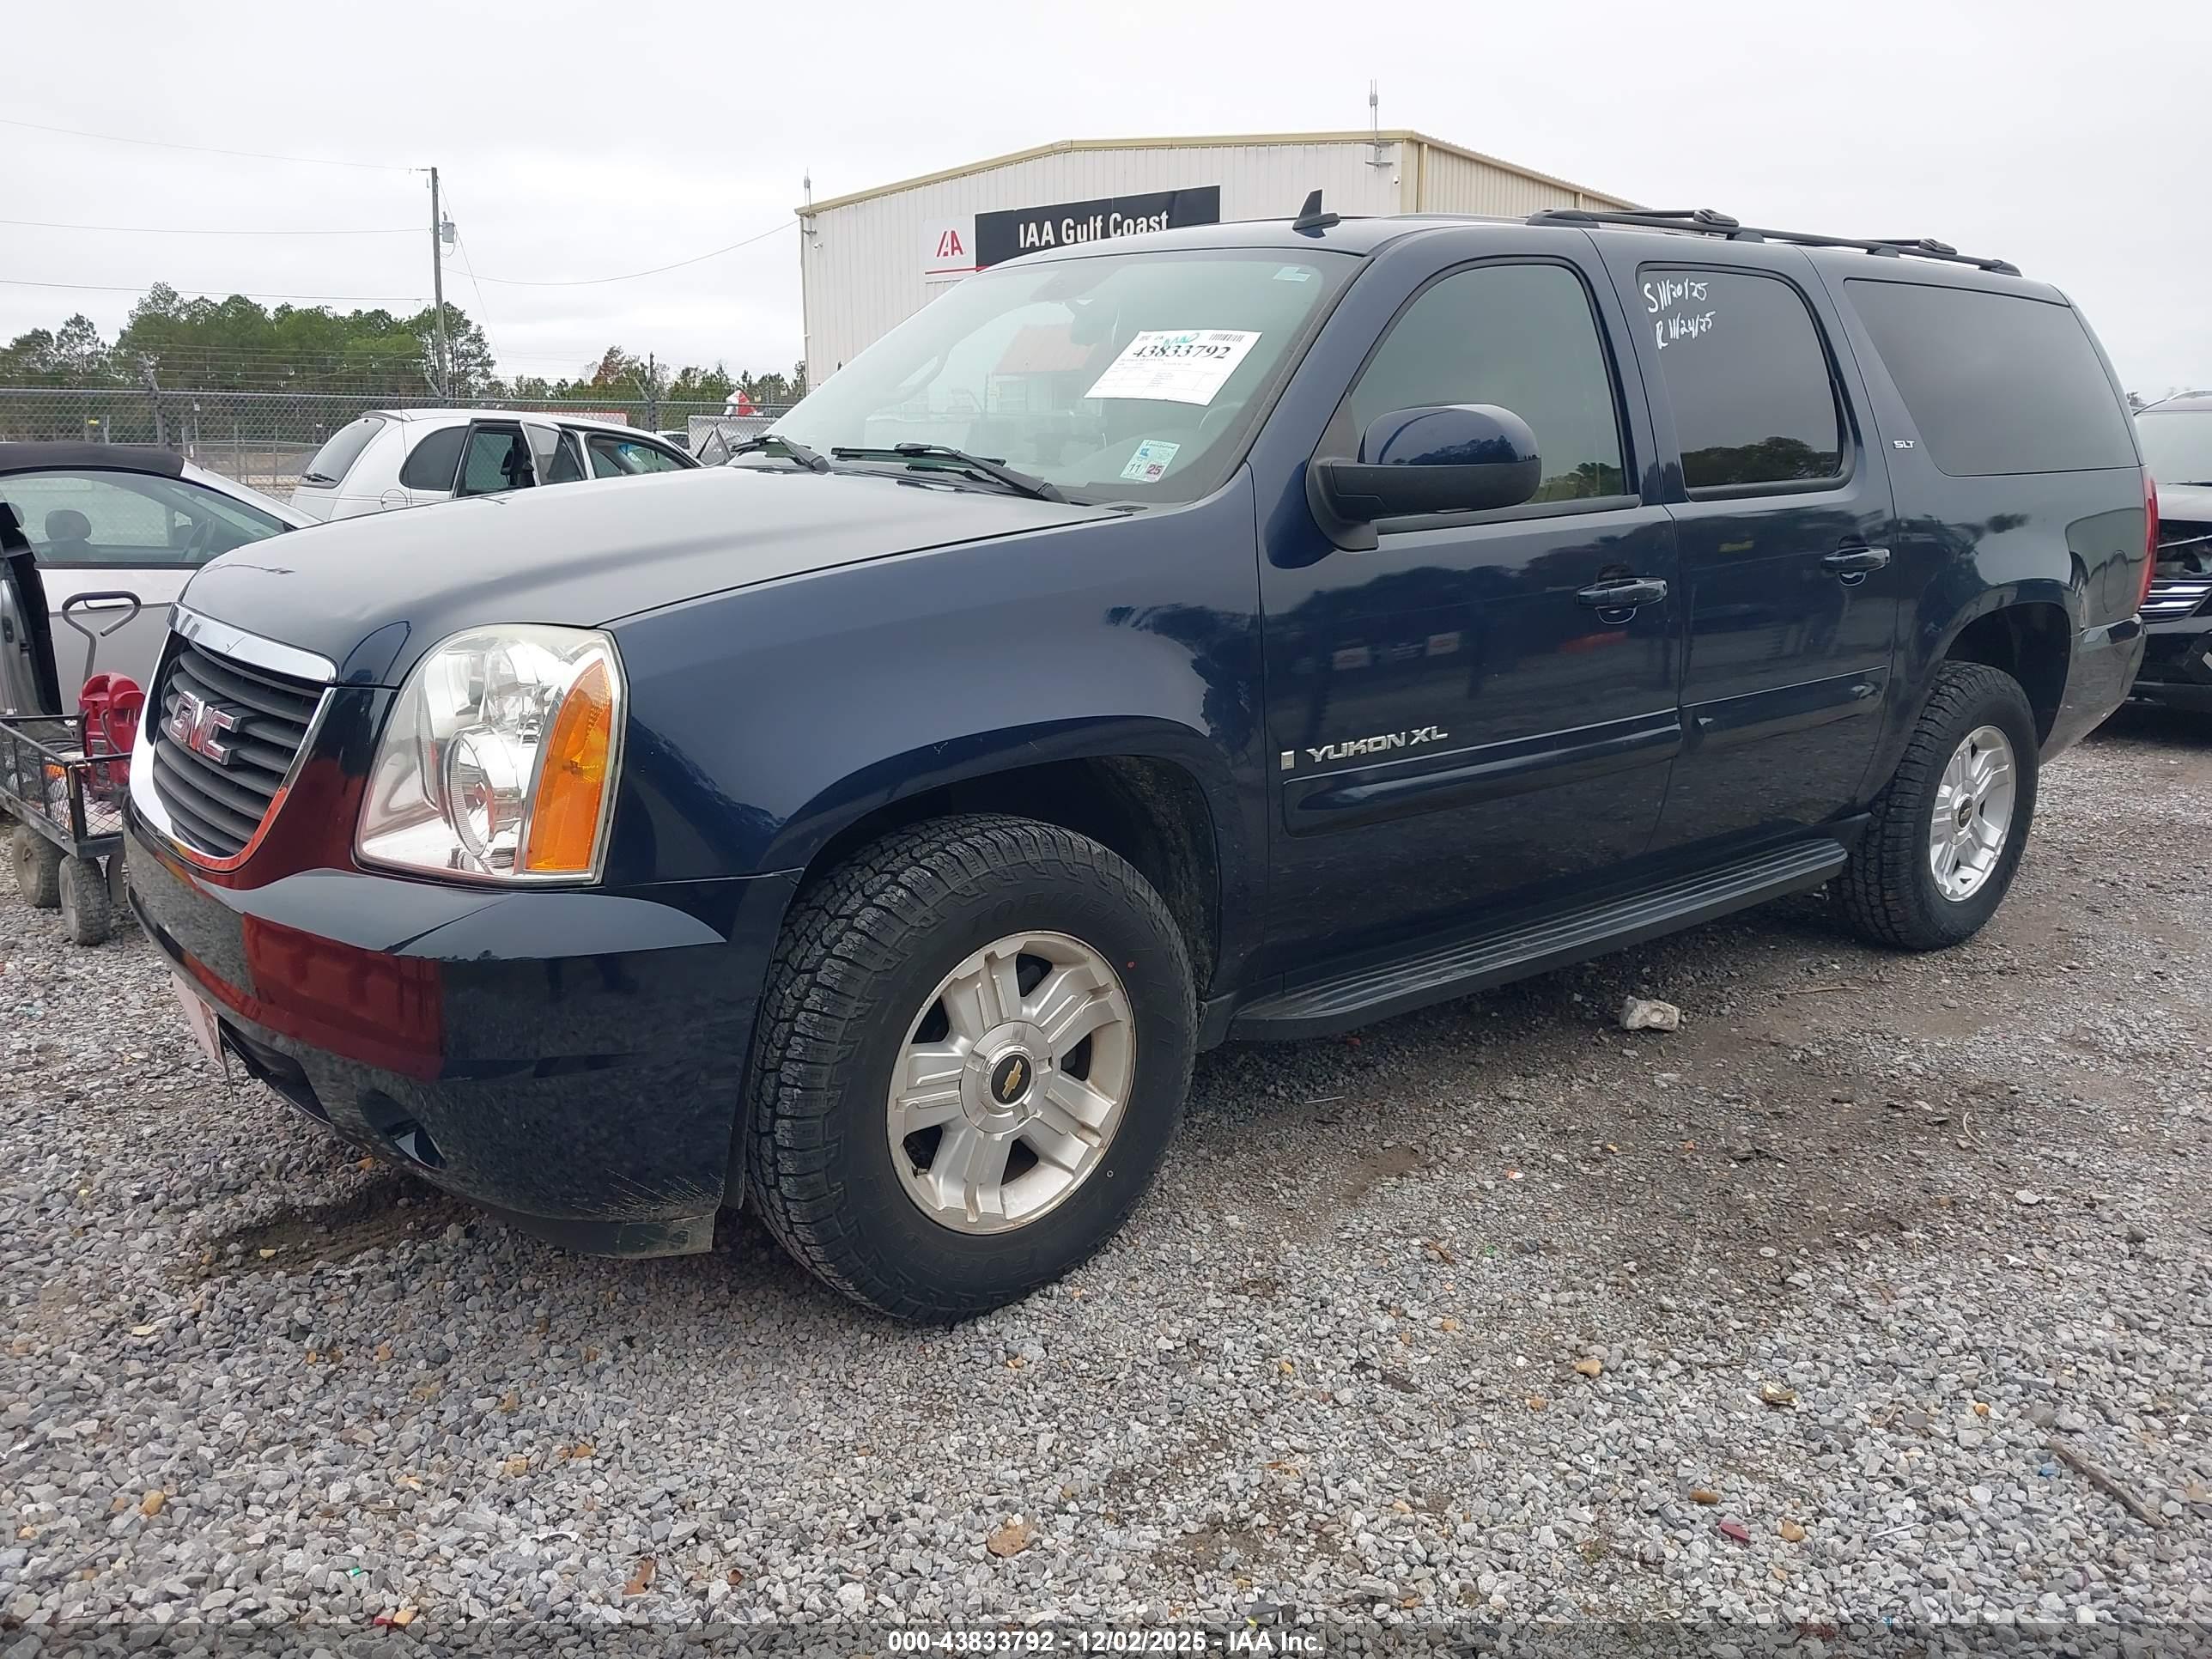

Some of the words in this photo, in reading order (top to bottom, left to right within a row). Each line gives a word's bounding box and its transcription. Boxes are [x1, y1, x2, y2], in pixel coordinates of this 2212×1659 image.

[1019, 221, 1055, 248] IAA
[1061, 215, 1103, 244] Gulf
[1109, 210, 1169, 238] Coast
[1133, 344, 1231, 360] 43833792
[1893, 440, 1916, 449] SLT
[1147, 464, 1164, 475] 25
[170, 690, 241, 765] GMC
[1305, 732, 1406, 763] YUKON
[1410, 726, 1449, 746] XL
